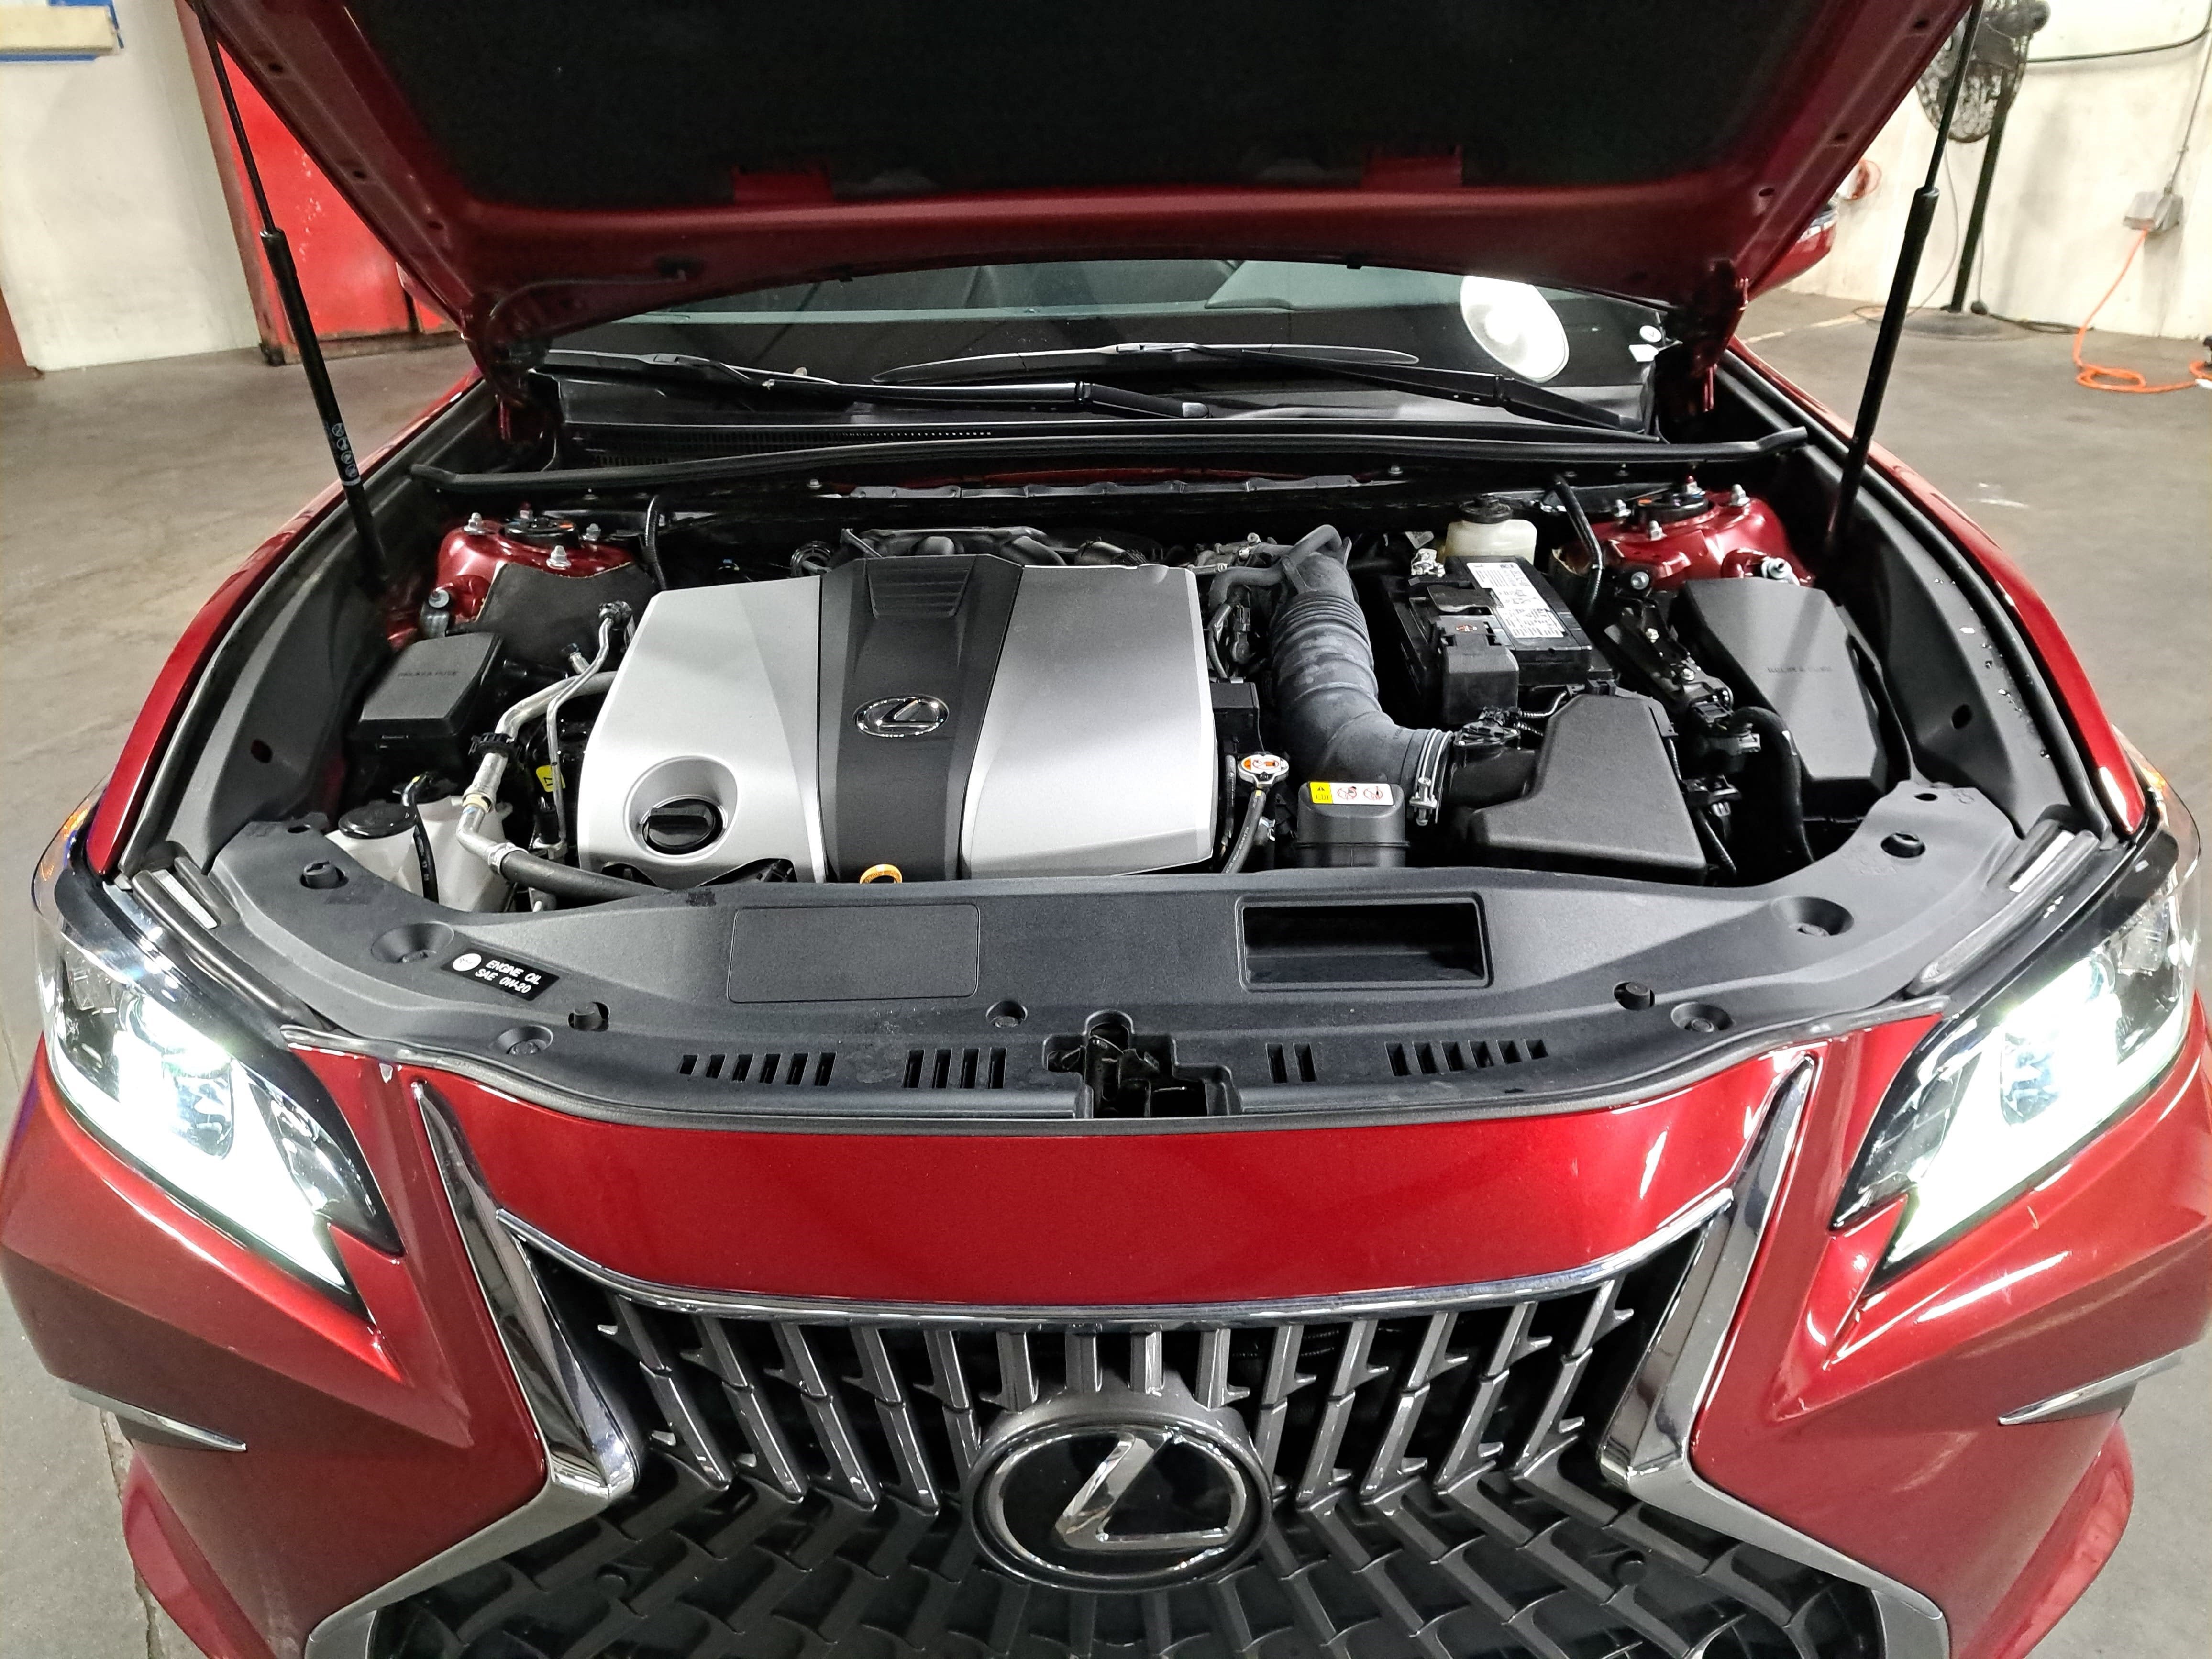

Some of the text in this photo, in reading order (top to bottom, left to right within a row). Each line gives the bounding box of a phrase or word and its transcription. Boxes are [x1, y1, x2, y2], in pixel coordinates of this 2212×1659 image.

[475, 968, 532, 994] SAE 0W-20
[486, 960, 542, 985] ENGINE OIL
